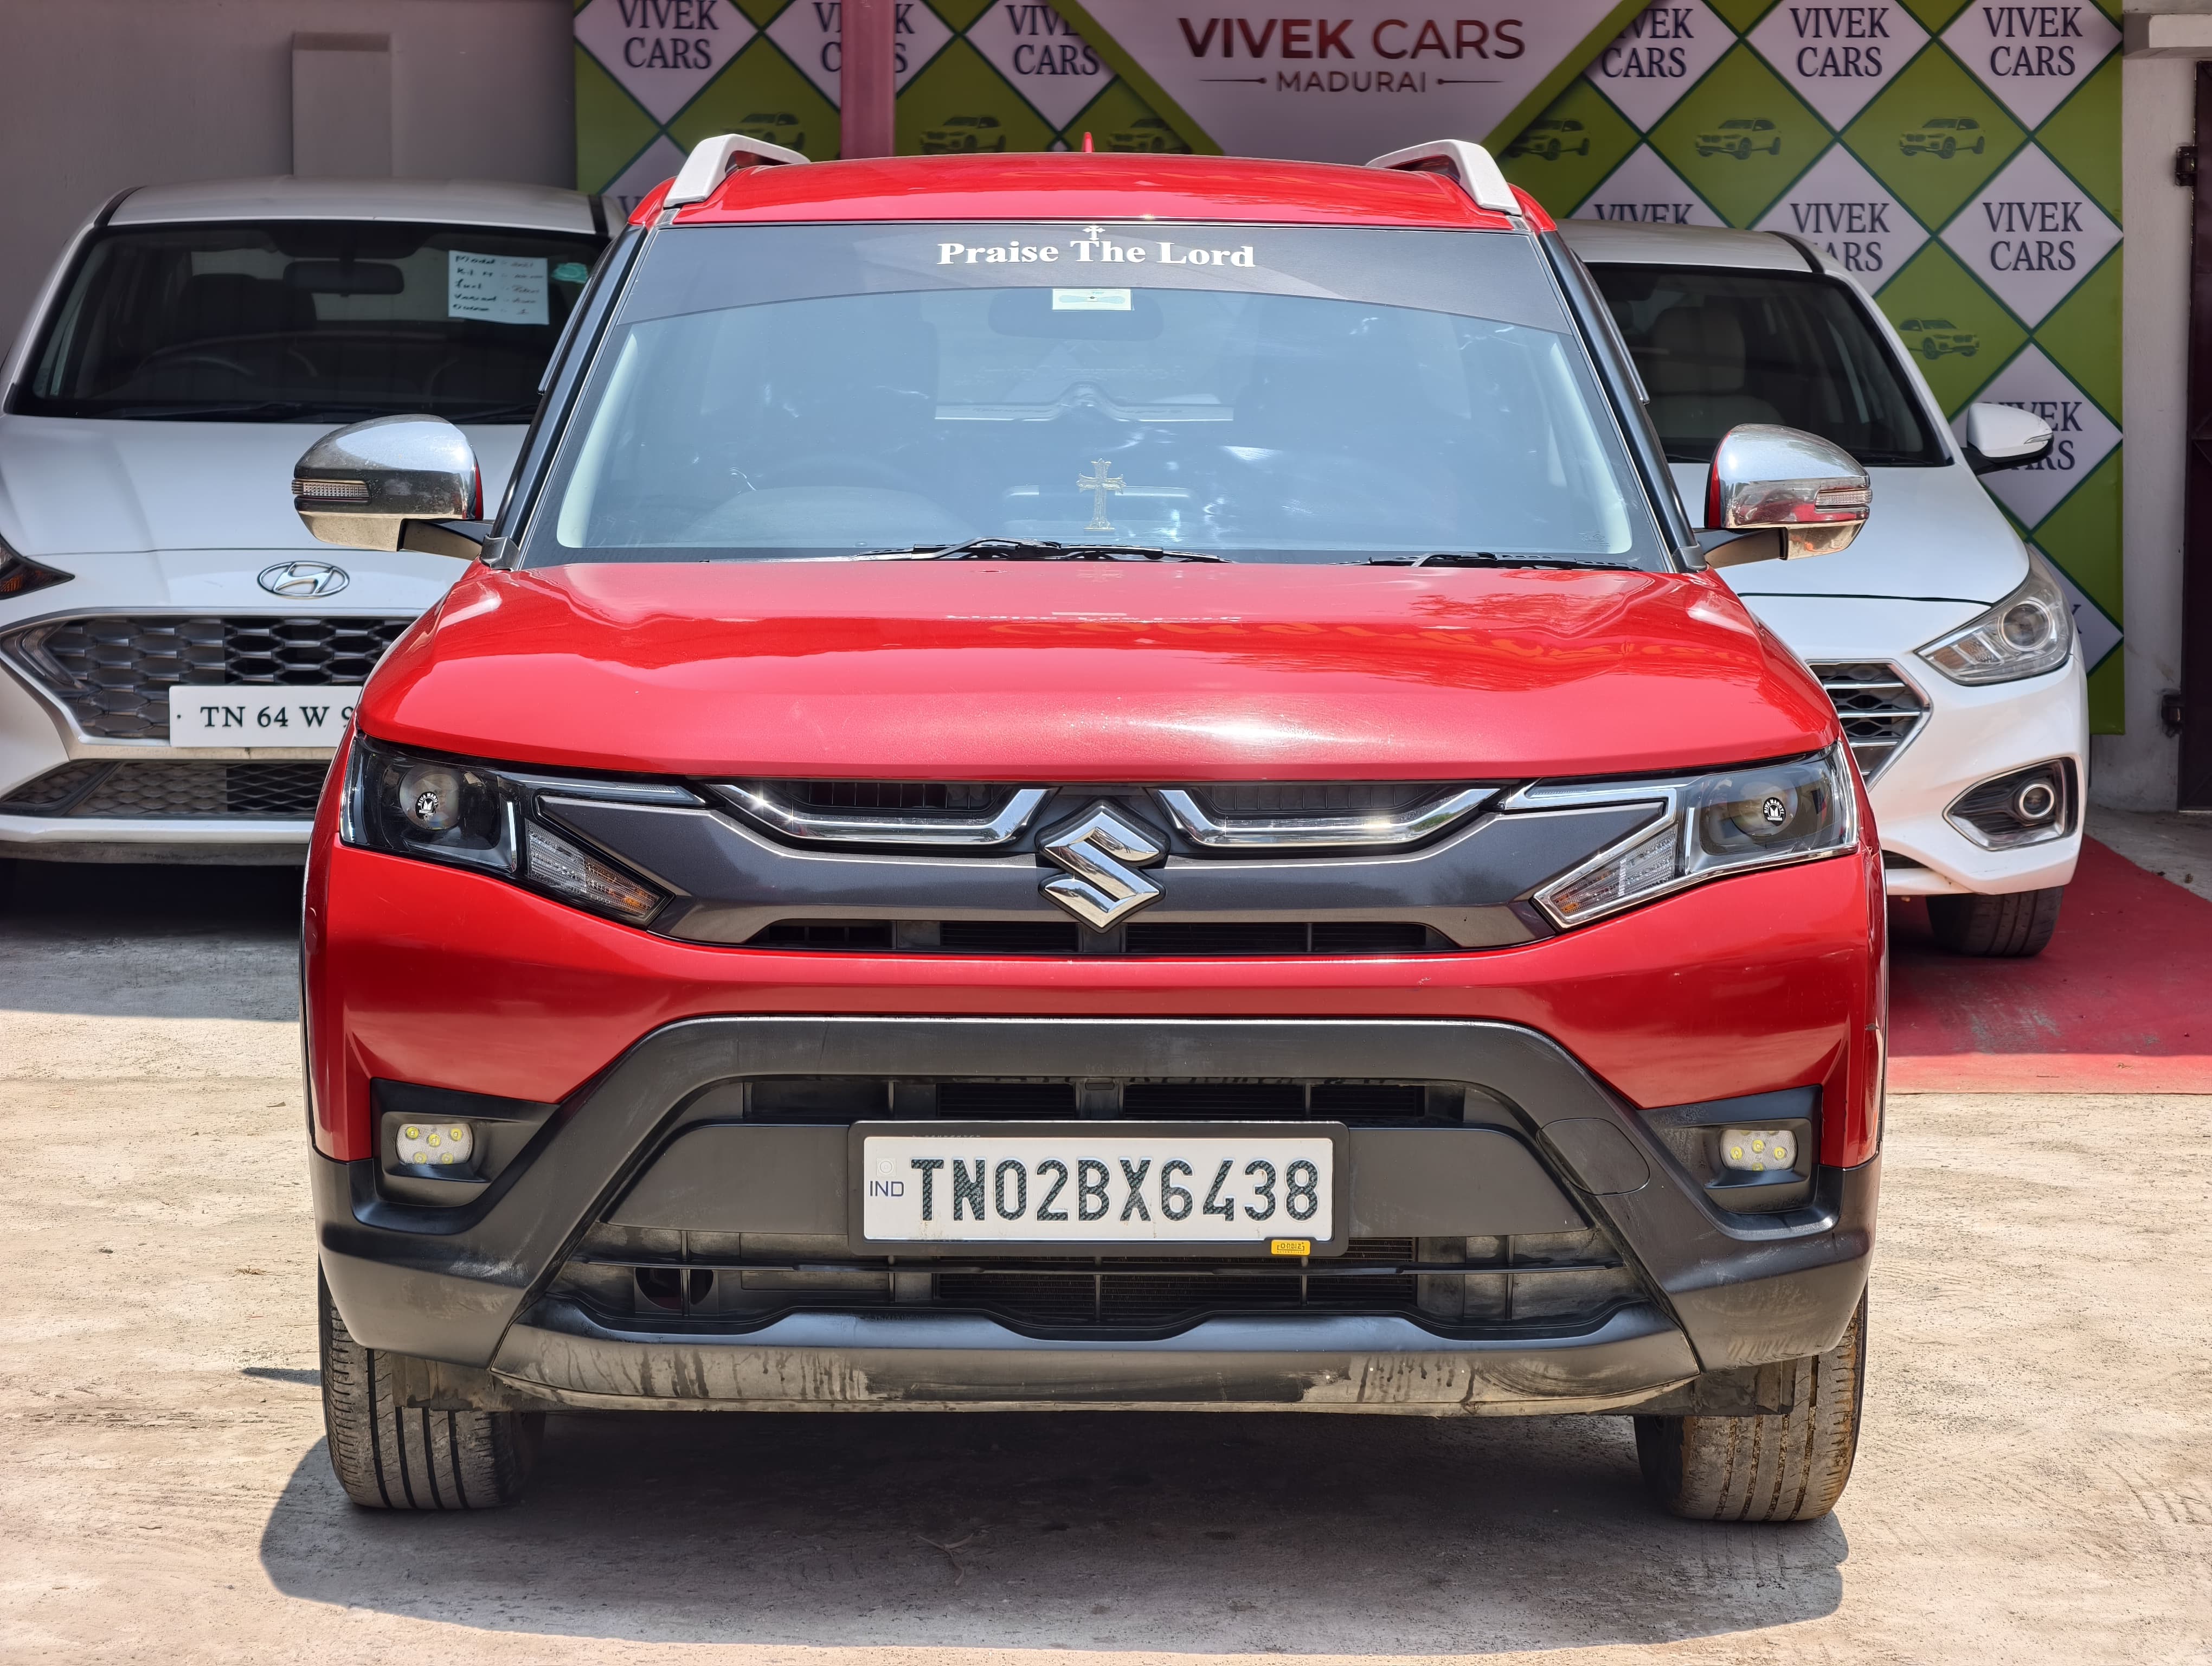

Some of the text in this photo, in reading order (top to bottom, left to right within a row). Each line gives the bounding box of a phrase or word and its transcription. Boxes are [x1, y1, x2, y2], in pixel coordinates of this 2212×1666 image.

[616, 0, 719, 30] VIVEK
[1790, 8, 1890, 39] VIVEK
[1983, 7, 2083, 37] VIVEK
[624, 37, 711, 69] CARS
[1178, 17, 1526, 60] VIVEK CARS
[1013, 44, 1100, 75] CARS
[1601, 47, 1687, 78] CARS
[1797, 47, 1882, 78] CARS
[1990, 46, 2076, 76] CARS
[1277, 71, 1426, 93] MADURAI
[1790, 203, 1891, 233] VIVEK
[1983, 202, 2083, 233] VIVEK
[937, 239, 1256, 268] Praise The Lord
[1990, 241, 2076, 272] CARS
[200, 706, 246, 728] TN
[257, 706, 288, 728] 64
[299, 706, 330, 727] W
[870, 1180, 904, 1197] IND
[910, 1158, 1319, 1221] TN02BX6438
